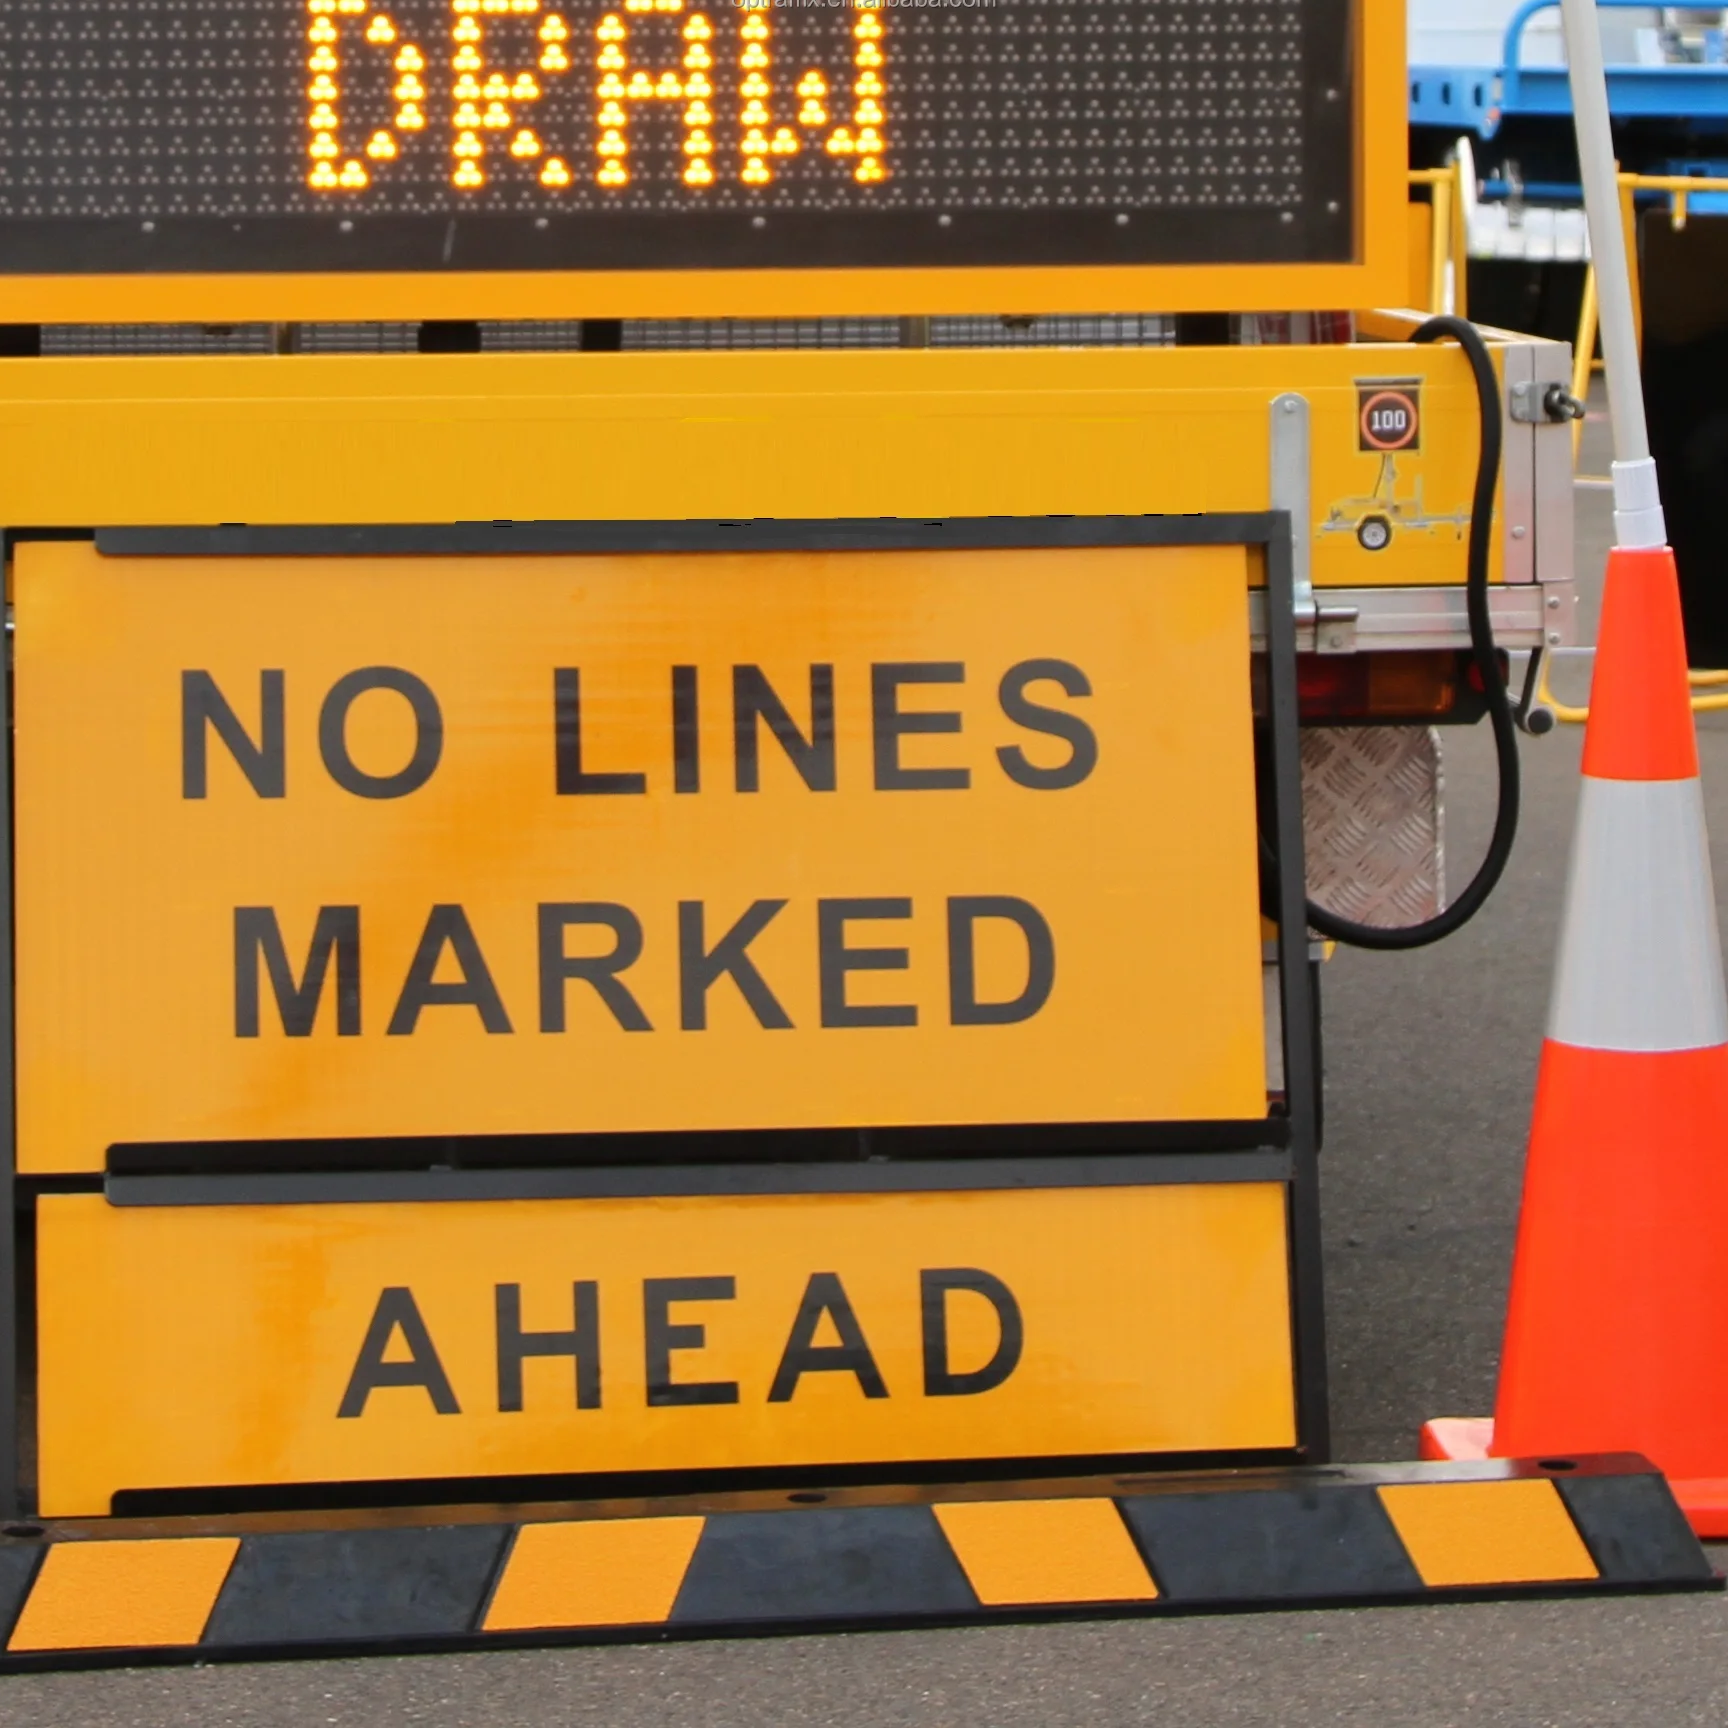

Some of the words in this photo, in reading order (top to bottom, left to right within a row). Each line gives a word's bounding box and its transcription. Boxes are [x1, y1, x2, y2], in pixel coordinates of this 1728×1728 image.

[1372, 409, 1406, 430] 100
[181, 666, 444, 800] NO
[553, 658, 1099, 796] LINES
[232, 896, 1057, 1038] MARKED
[335, 1267, 1024, 1419] AHEAD
